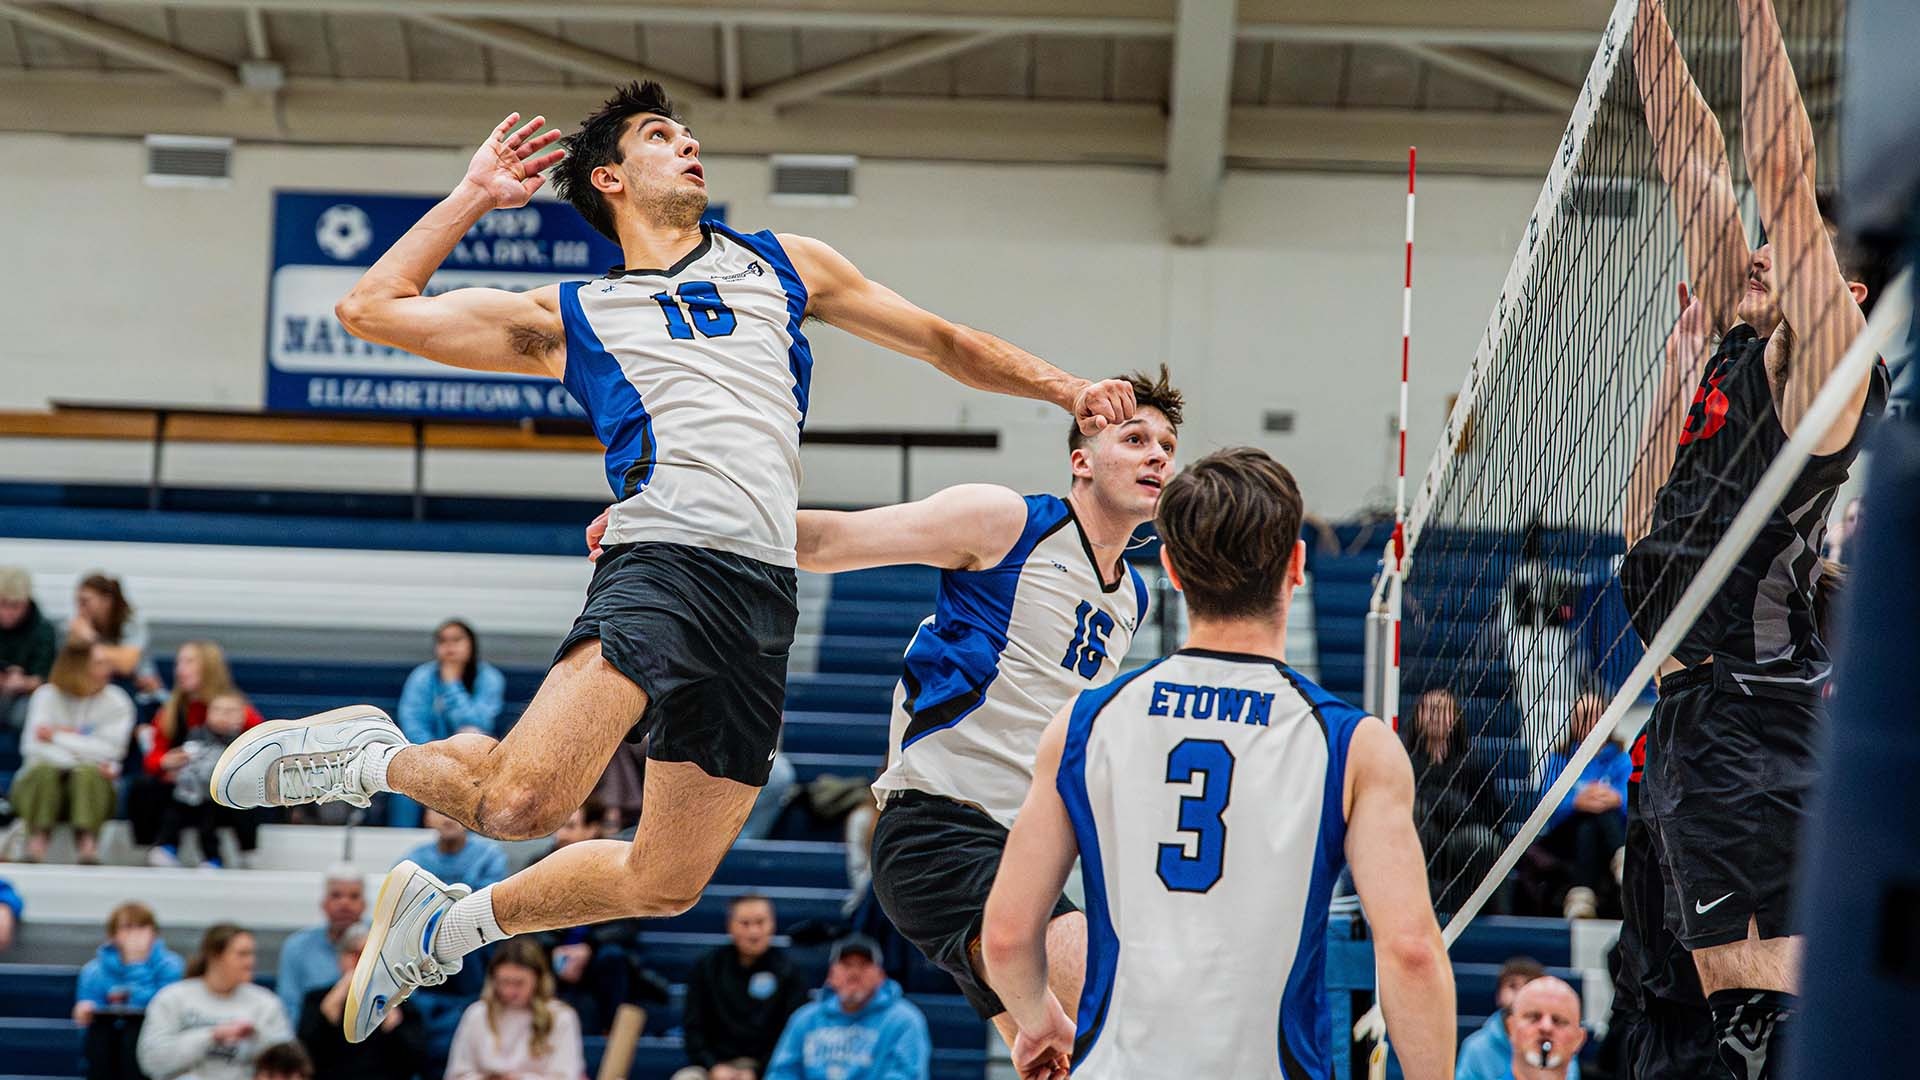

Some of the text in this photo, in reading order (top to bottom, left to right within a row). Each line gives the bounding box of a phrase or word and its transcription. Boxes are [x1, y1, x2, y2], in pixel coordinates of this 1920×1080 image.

[650, 281, 738, 340] 18
[308, 377, 543, 412] ELIZABETHTOWN
[1060, 599, 1115, 680] 16
[1148, 681, 1275, 727] ETOWN
[1155, 737, 1236, 894] 3
